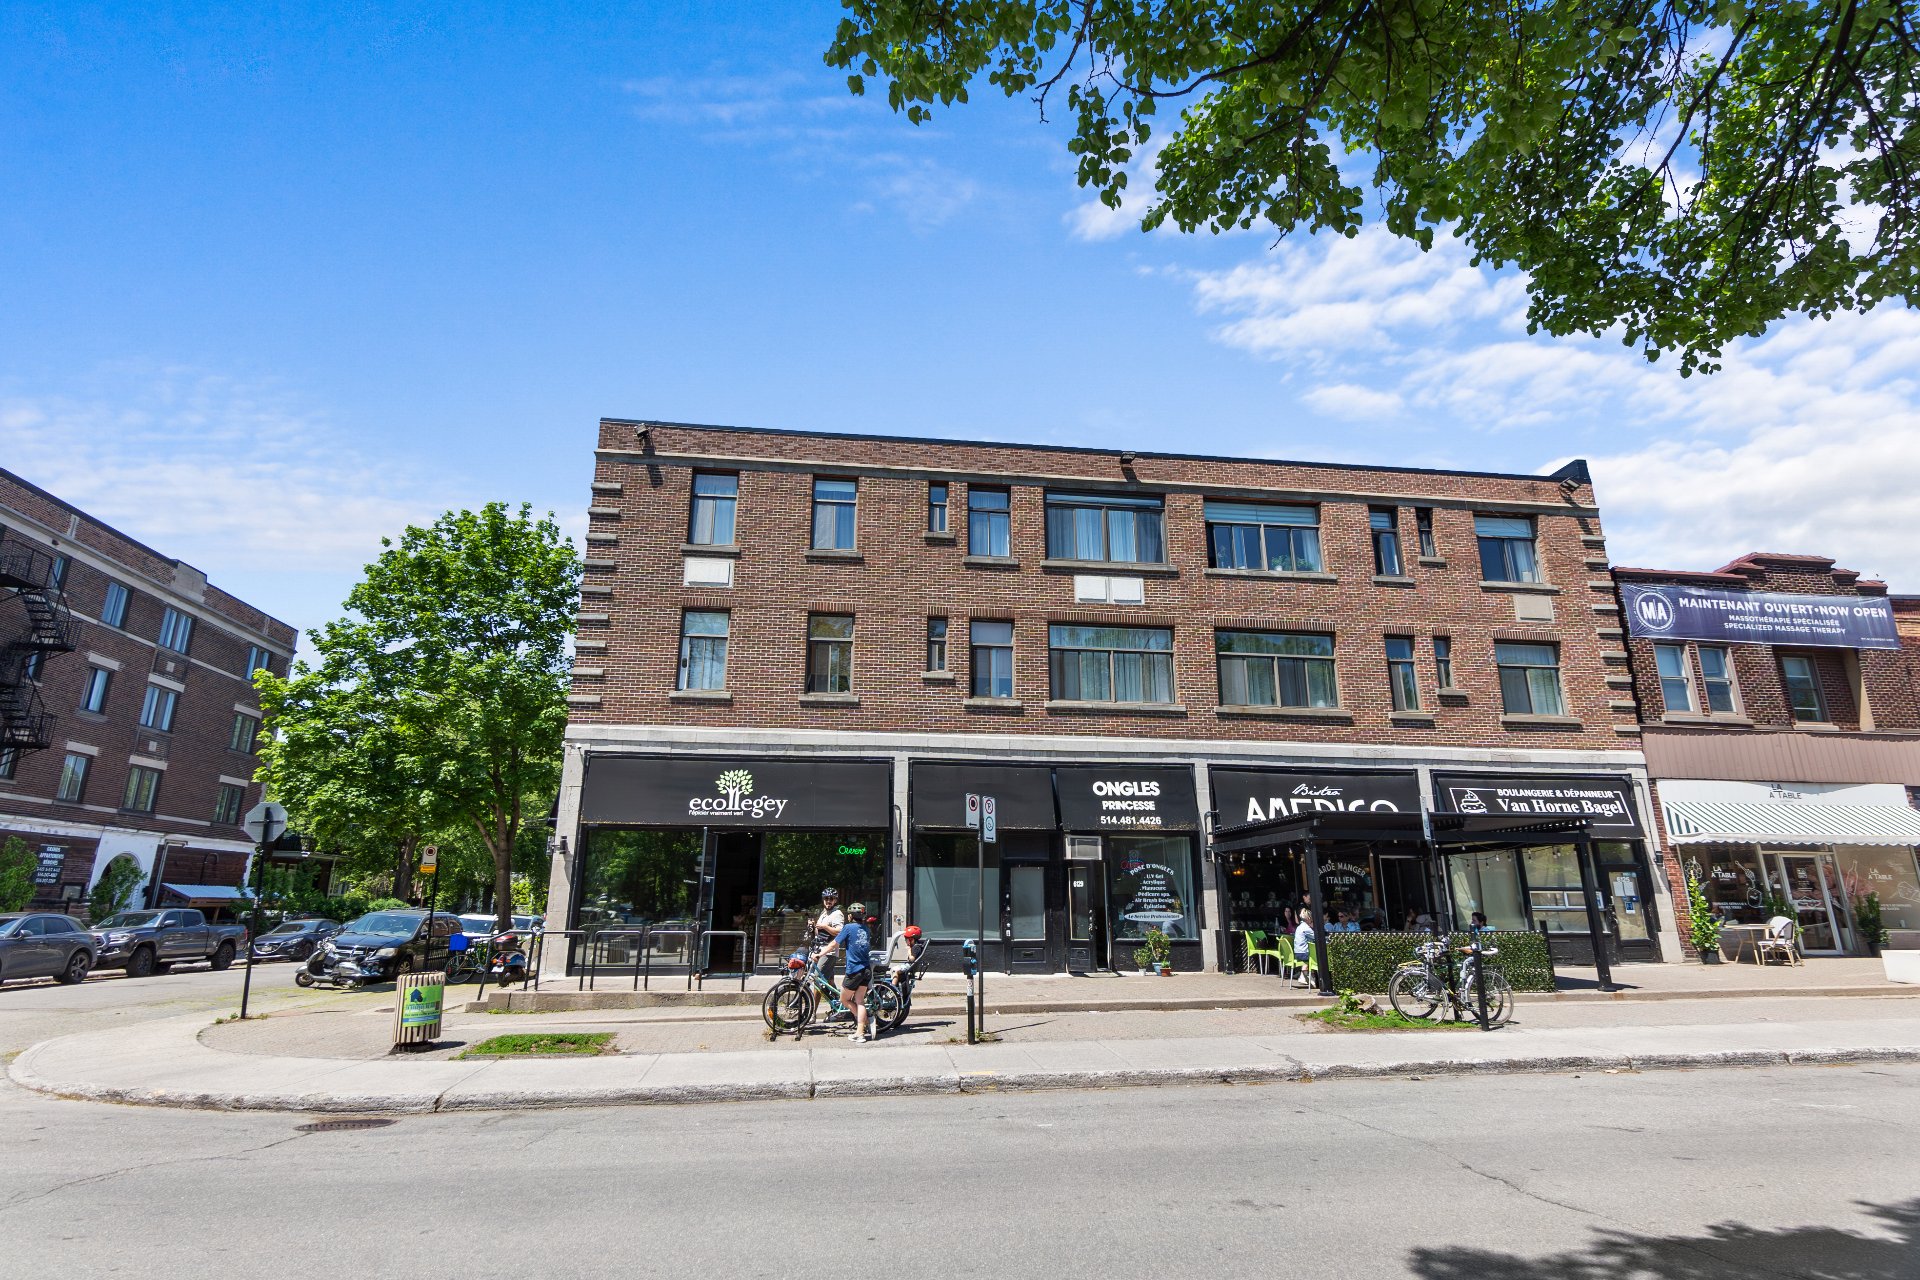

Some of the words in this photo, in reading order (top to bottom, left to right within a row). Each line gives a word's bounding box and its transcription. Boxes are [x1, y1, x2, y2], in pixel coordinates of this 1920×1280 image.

[1679, 598, 1760, 612] MAINTENANT
[1853, 607, 1887, 618] OPEN
[1729, 615, 1791, 624] MASSOTHÉRAPIE
[1793, 618, 1840, 627] SPÉCIALISÉE
[1724, 623, 1773, 631] SPECIALIZED
[1775, 625, 1810, 633] MASSAGE
[1092, 781, 1160, 796] ONGLES
[1292, 783, 1343, 796] Bistro
[1497, 789, 1555, 798] BOULANGERIE
[1556, 789, 1564, 798] &
[1563, 788, 1615, 798] DÉPANNEUR
[1773, 790, 1802, 799] TABLE
[1102, 801, 1156, 811] PRINCESSE
[1496, 799, 1530, 812] Van
[1530, 799, 1580, 813] Horne
[1580, 800, 1624, 817] Bagel
[1100, 816, 1162, 825] 514.481.4426
[1318, 862, 1336, 876] ARDE
[1326, 876, 1356, 884] ITALIEN
[1714, 871, 1737, 879] TABLE
